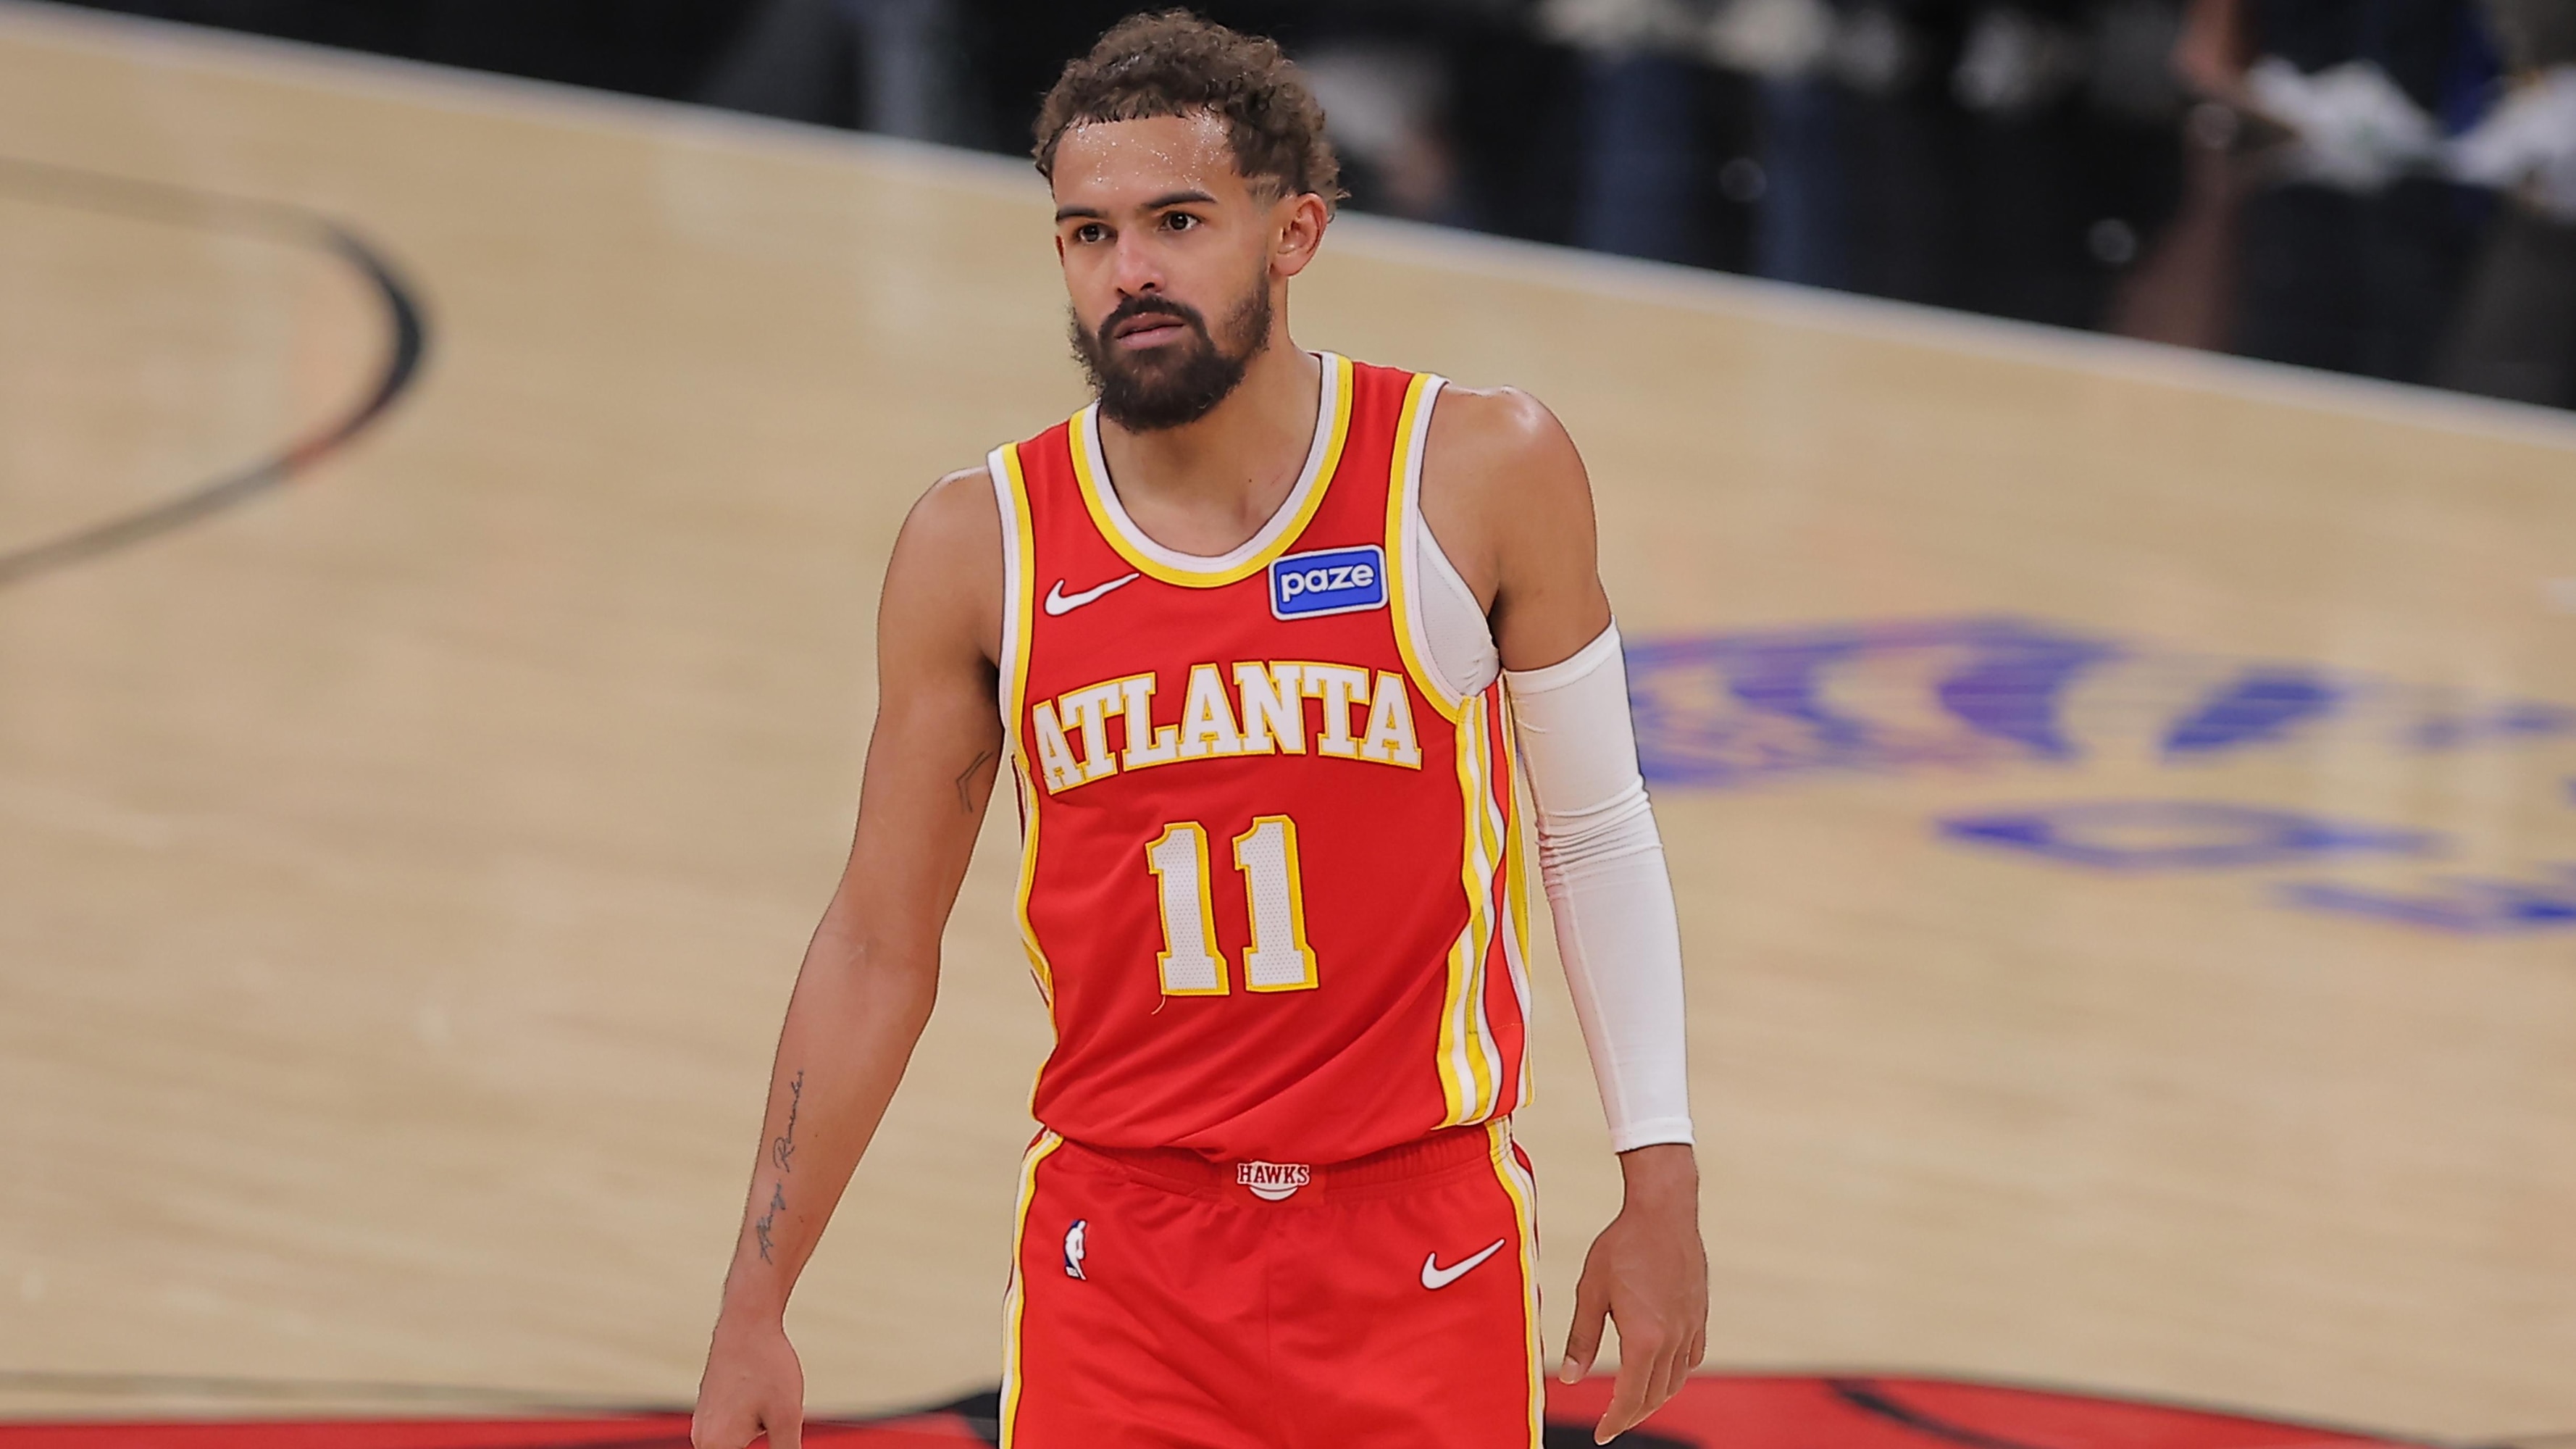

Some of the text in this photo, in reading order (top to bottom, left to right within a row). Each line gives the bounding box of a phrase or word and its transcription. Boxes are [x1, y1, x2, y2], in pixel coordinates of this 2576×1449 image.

[1281, 564, 1374, 602] paze
[1033, 660, 1423, 796] ATLANTA
[1145, 814, 1319, 995] 11
[1239, 1164, 1308, 1185] HAWKS
